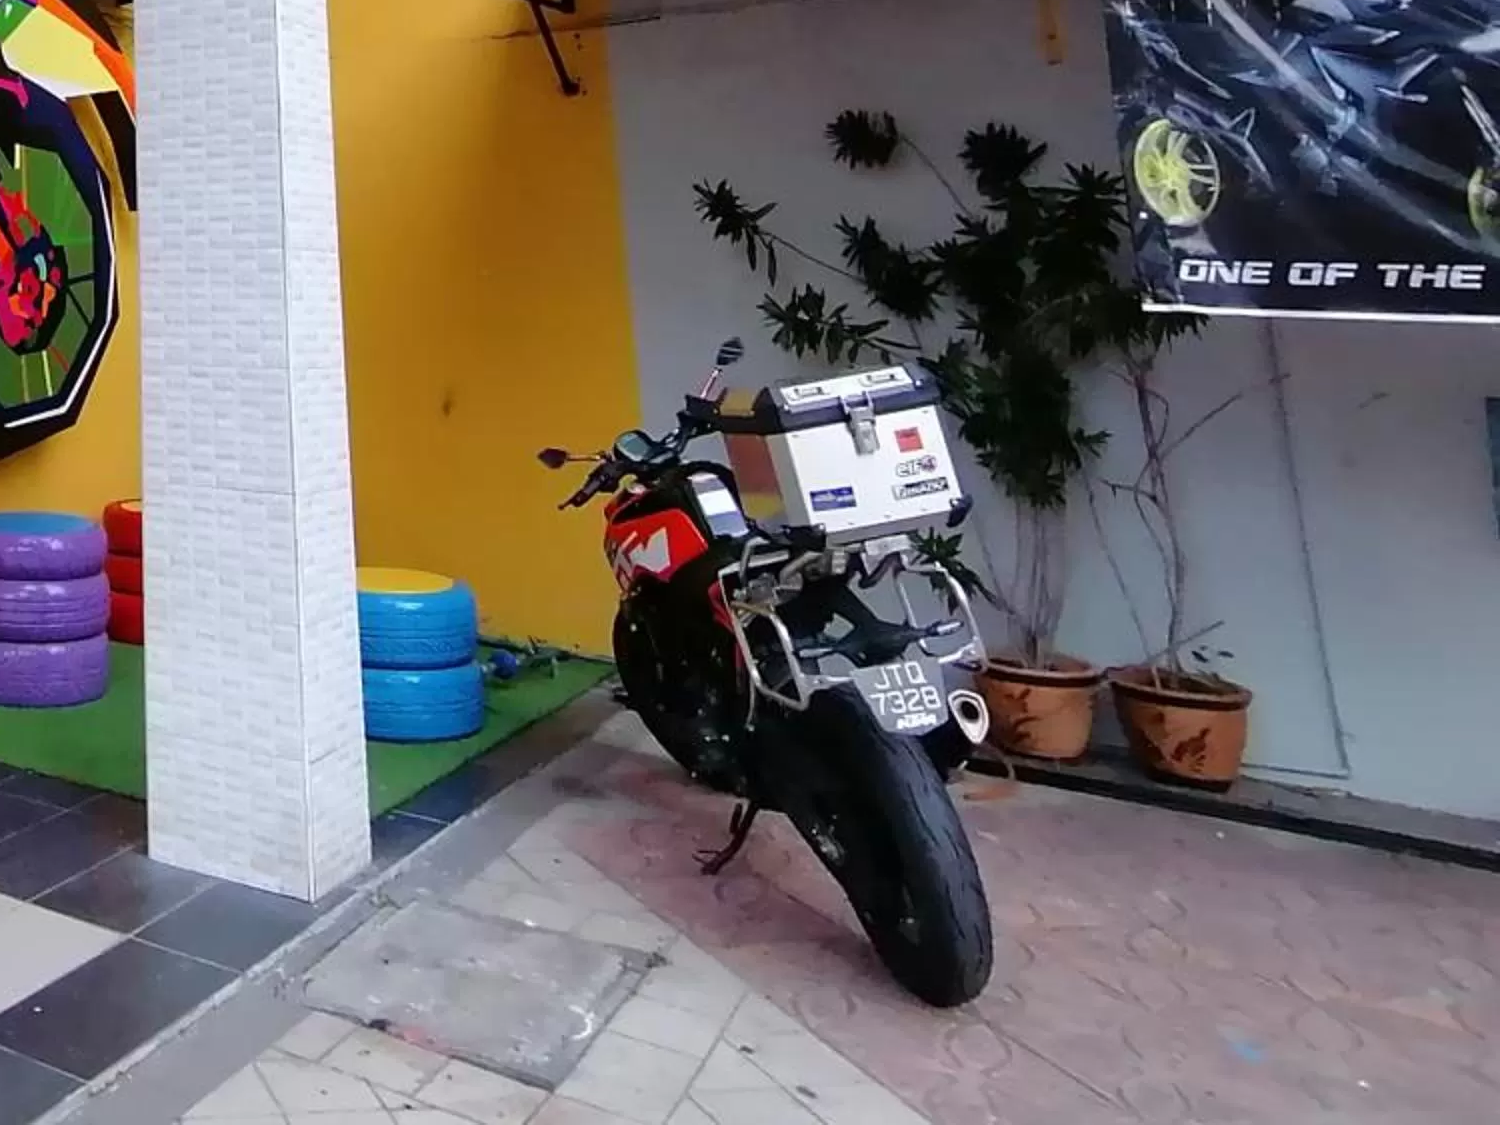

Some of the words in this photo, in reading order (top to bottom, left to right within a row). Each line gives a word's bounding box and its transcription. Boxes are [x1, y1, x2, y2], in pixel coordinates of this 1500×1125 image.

[1179, 259, 1273, 285] ONE
[1288, 262, 1358, 286] OF
[1377, 263, 1486, 289] THE
[874, 661, 928, 690] JTQ
[869, 686, 942, 716] 7328
